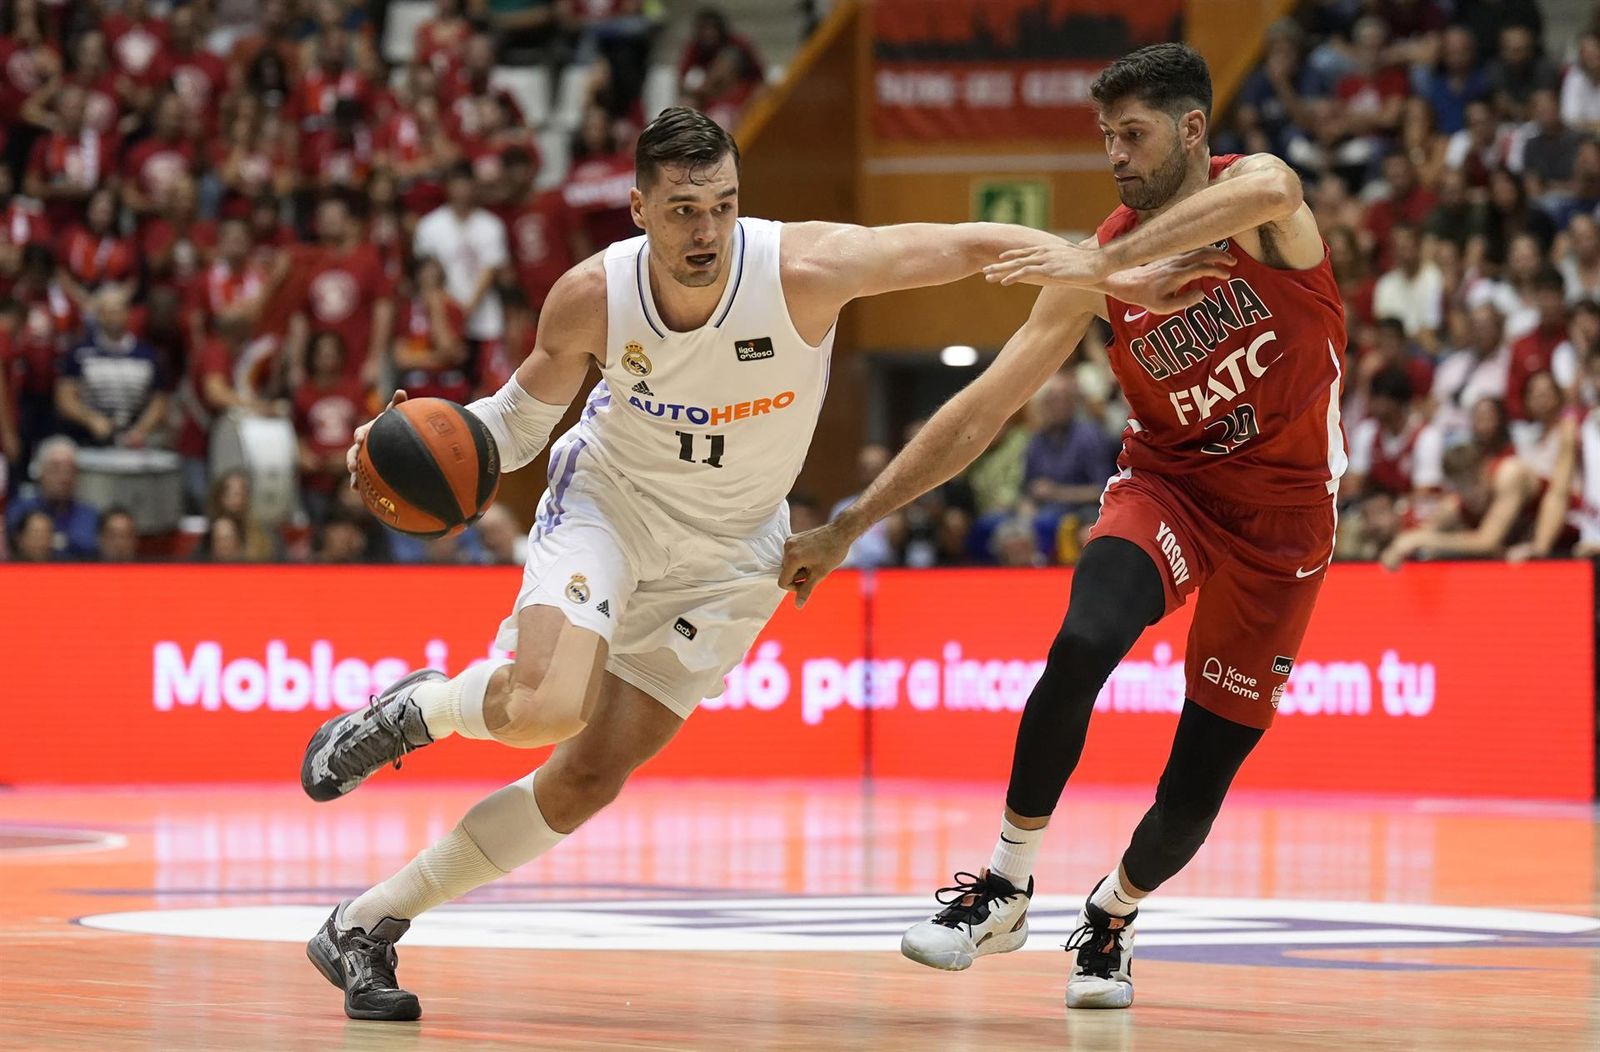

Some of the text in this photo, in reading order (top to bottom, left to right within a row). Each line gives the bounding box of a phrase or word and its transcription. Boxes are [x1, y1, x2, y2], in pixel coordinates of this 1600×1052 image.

[1130, 278, 1273, 382] GIRONA
[738, 346, 754, 355] liga
[740, 350, 773, 360] endesa
[1169, 330, 1284, 427] FIATC
[627, 391, 796, 427] AUTOHERO
[675, 430, 725, 469] 11
[152, 640, 411, 712] Mobles
[1377, 648, 1436, 717] tu
[1221, 677, 1260, 700] Home
[1226, 666, 1257, 687] Kave
